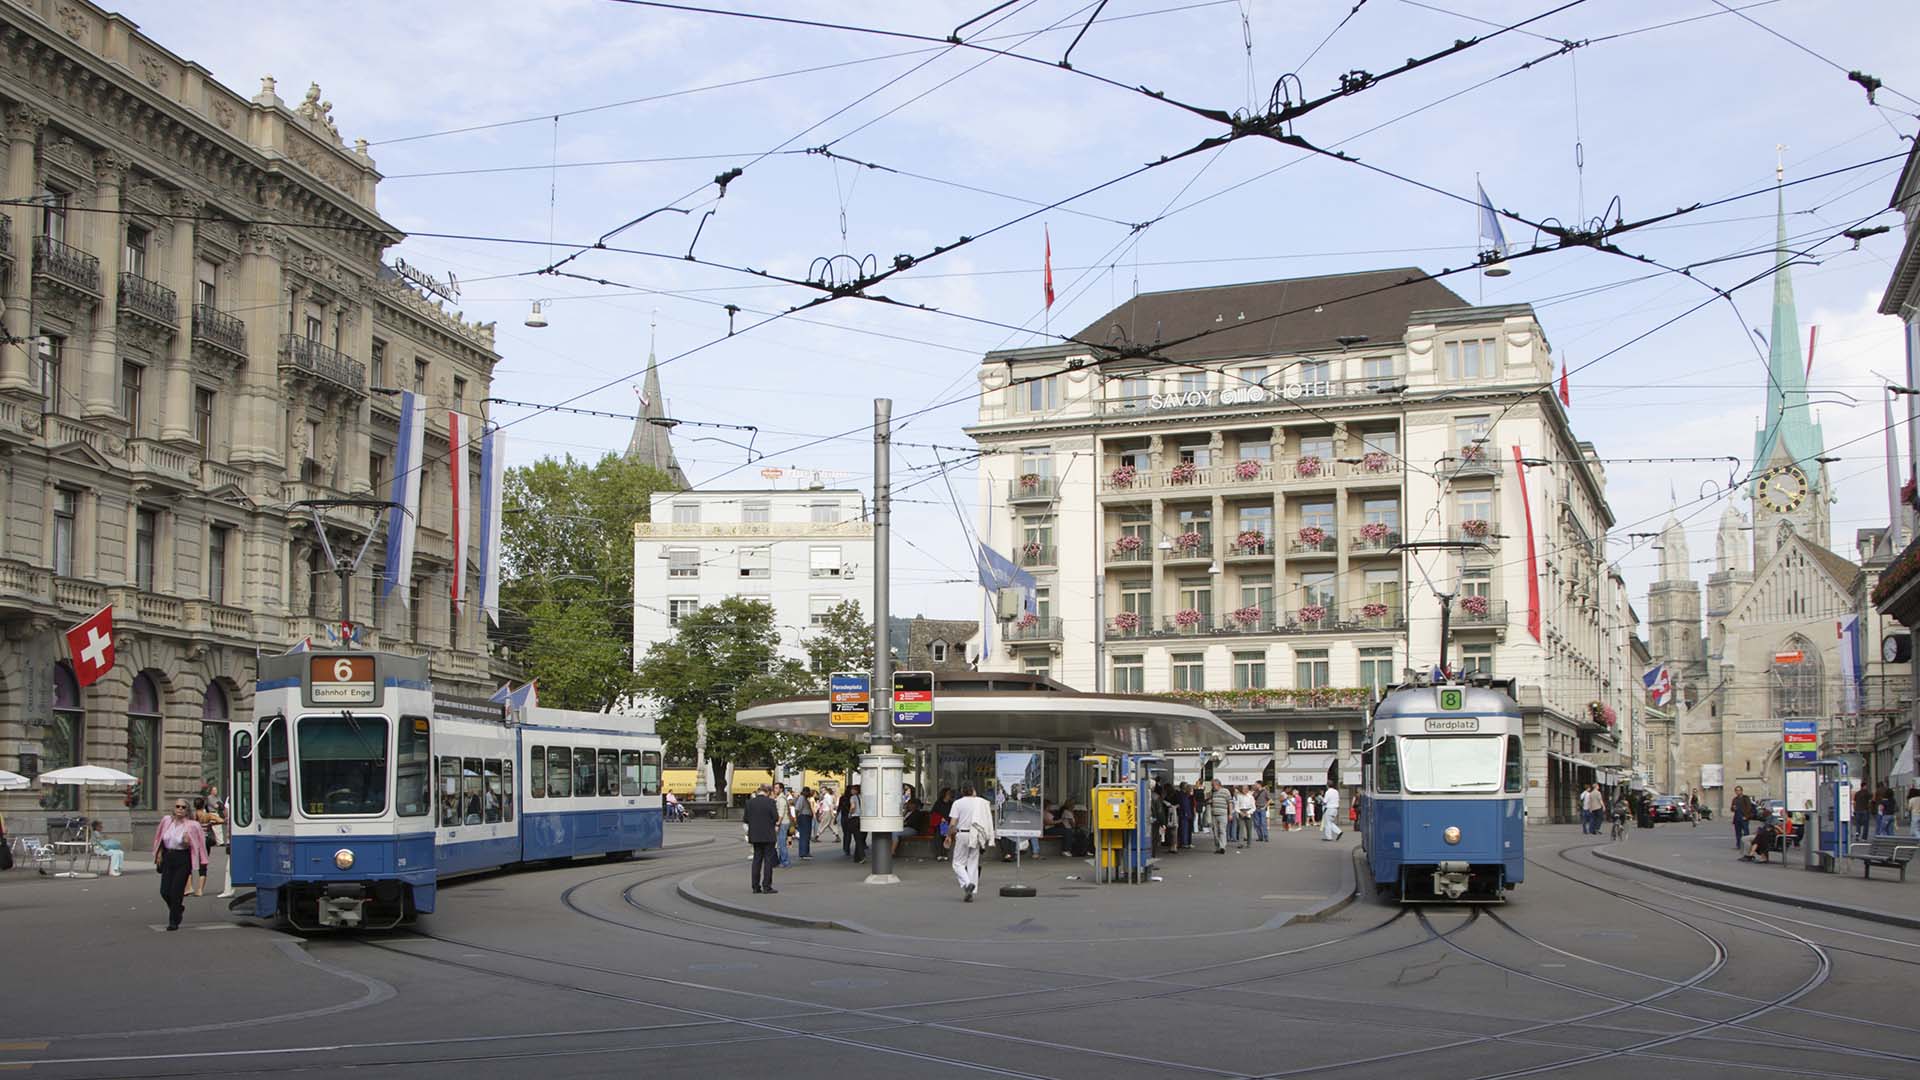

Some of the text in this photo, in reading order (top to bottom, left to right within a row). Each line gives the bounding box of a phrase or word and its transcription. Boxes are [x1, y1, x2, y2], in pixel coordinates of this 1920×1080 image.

[1150, 381, 1336, 410] SAVOY HOTEL
[334, 658, 353, 682] 6
[351, 689, 371, 697] Enge
[1446, 693, 1456, 706] 8
[899, 713, 905, 721] 9
[1428, 721, 1475, 729] Hardplatz
[1296, 739, 1328, 749] TÜRLER
